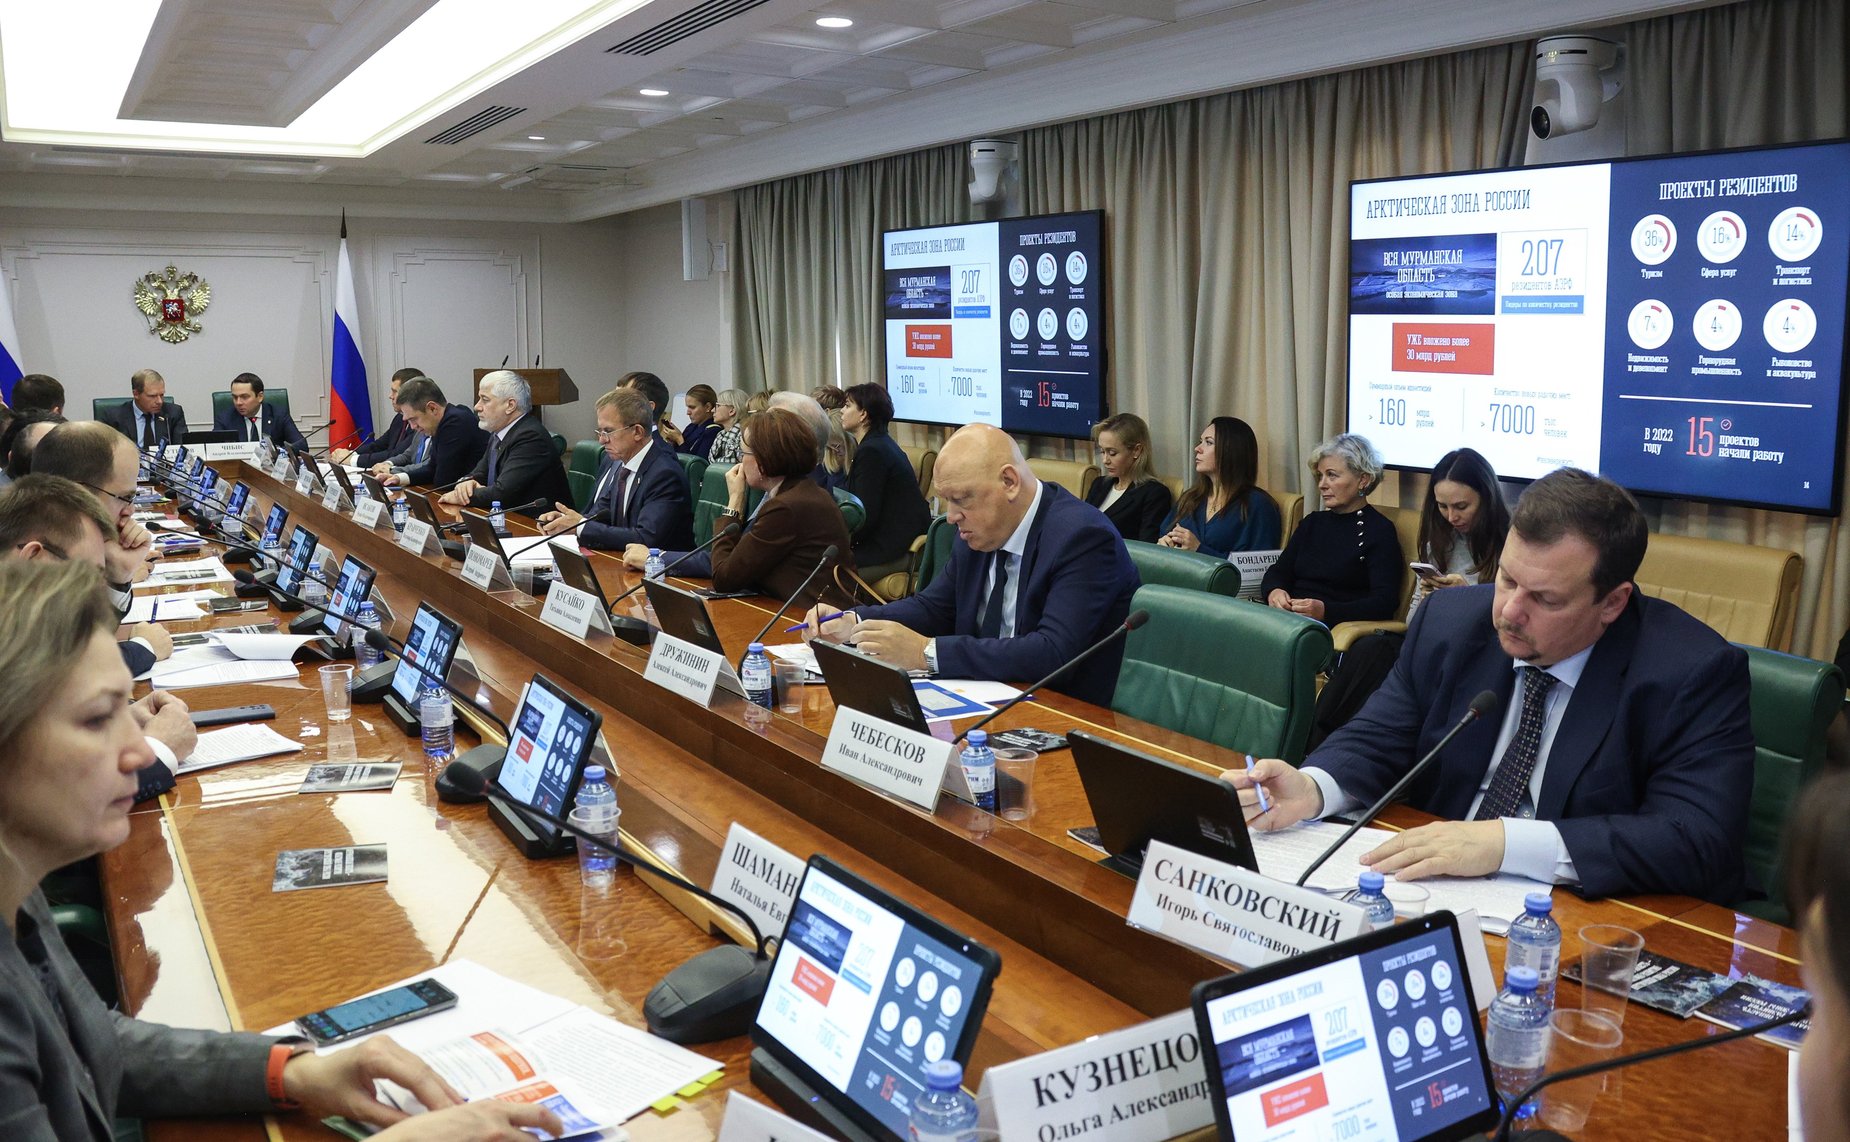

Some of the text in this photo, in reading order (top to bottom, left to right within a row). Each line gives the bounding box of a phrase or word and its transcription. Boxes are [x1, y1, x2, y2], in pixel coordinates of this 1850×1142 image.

[1659, 174, 1798, 200] ПРОЕКТЫ РЕЗИДЕНТОВ
[1366, 189, 1531, 219] АРКТИЧЕСКАЯ ЗОНА РОССИИ
[1383, 250, 1463, 266] ВСЯ МУРМАНСКАЯ
[1521, 239, 1564, 276] 207
[961, 269, 980, 293] 207
[1397, 268, 1435, 283] ОБЛАСТЬ
[1407, 334, 1422, 345] УЖЕ
[1407, 349, 1414, 359] 30
[901, 375, 914, 393] 160
[951, 376, 972, 397] 7000
[1038, 381, 1050, 407] 15
[1379, 398, 1405, 426] 160
[1490, 403, 1535, 434] 7000
[1644, 428, 1673, 441] В 2022
[1686, 416, 1714, 457] 15
[1719, 435, 1759, 447] проектов
[1643, 443, 1661, 455] году
[1718, 447, 1784, 464] начали работу
[555, 589, 585, 610] КУСАЙКО
[660, 643, 710, 673] ДРУЖИНИН
[653, 660, 707, 691] Алексей Александрович
[851, 721, 926, 764] ЧЕБЕСКОВ
[839, 742, 923, 787] Иван Александрович
[732, 842, 798, 897] ШАМАН
[730, 877, 768, 912] Наталья
[1154, 859, 1342, 943] САНКОВСКИЙ
[1156, 893, 1307, 957] Игорь Святославов
[1030, 1033, 1199, 1109] КУЗНЕЦО
[1038, 1114, 1103, 1142] Ольга
